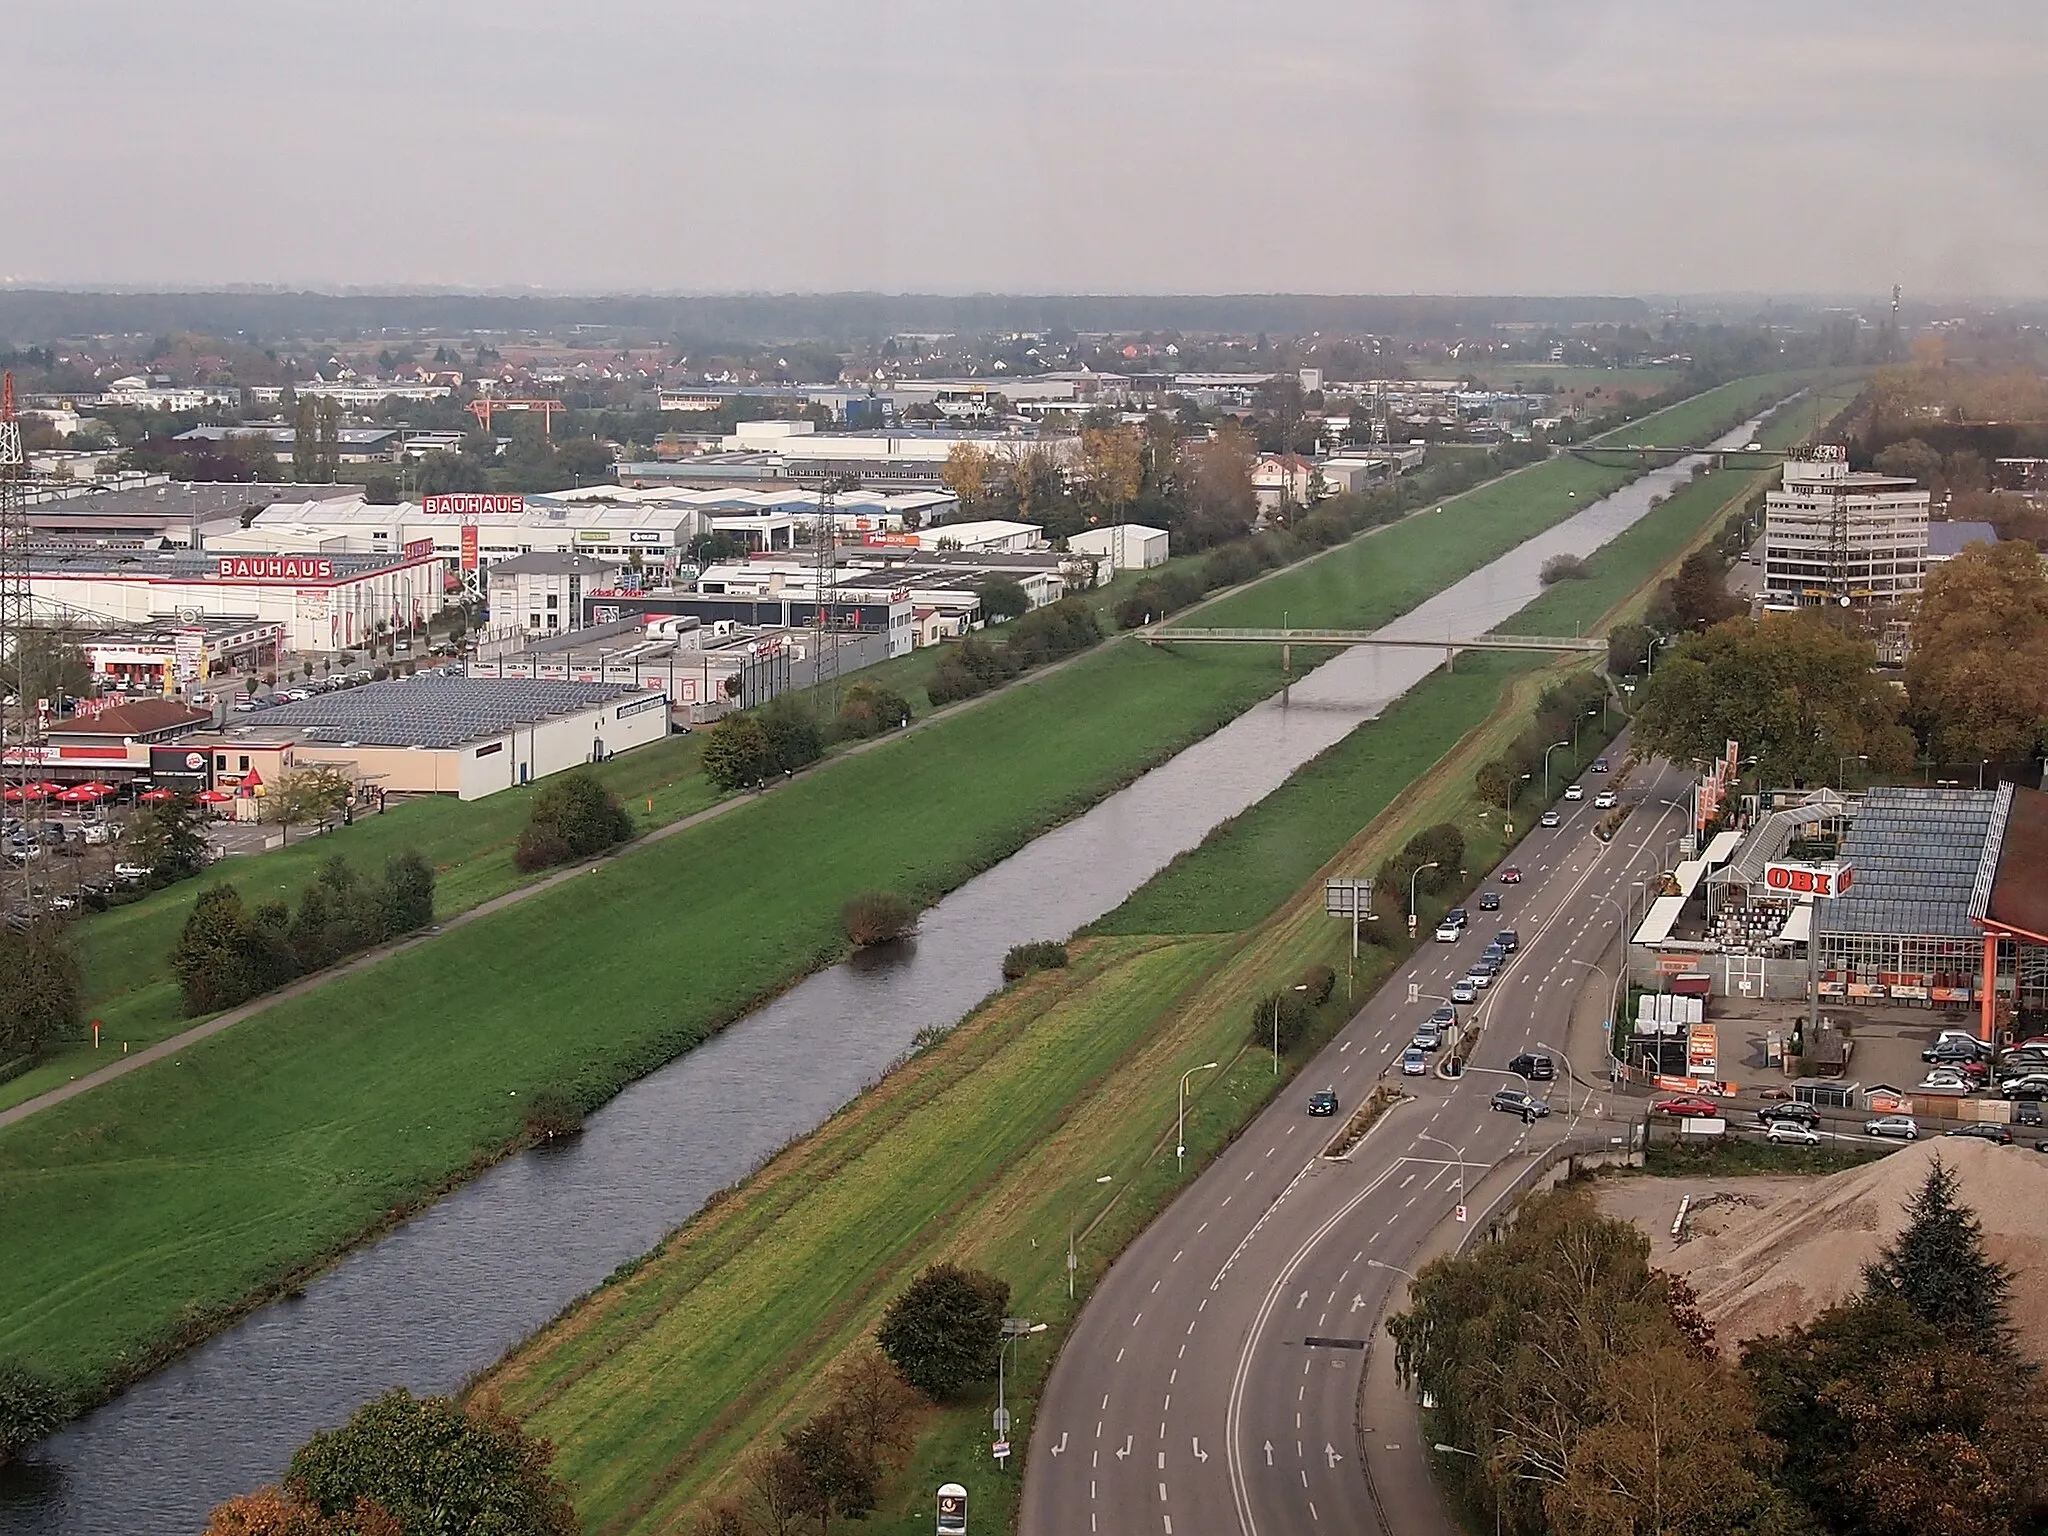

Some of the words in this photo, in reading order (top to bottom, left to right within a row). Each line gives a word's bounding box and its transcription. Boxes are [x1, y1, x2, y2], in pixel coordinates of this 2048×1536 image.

[425, 497, 523, 513] BAUHAUS
[220, 560, 332, 577] BAUHAUS
[1767, 867, 1831, 895] OBI
